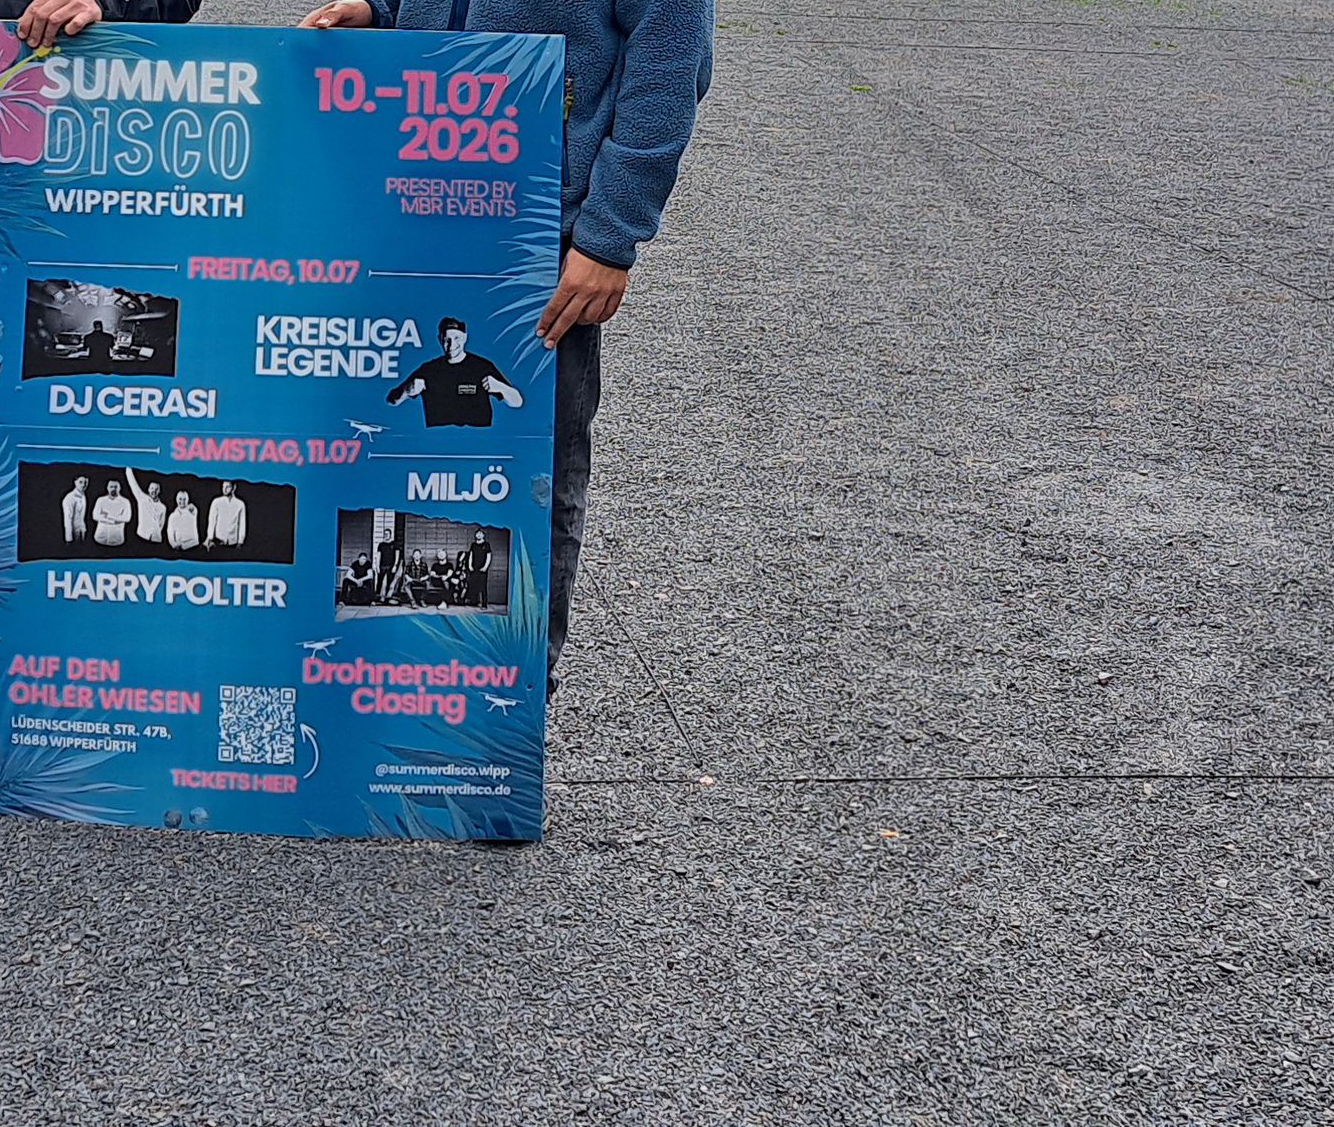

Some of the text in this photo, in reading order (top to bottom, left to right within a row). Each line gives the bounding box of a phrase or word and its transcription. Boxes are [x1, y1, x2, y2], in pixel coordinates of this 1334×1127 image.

[39, 56, 261, 105] SUMMER
[398, 117, 520, 163] 2026
[45, 185, 244, 218] WIPPERFÜRTH
[385, 177, 517, 199] PRESENTED BY
[400, 197, 517, 218] MBR EVENTS
[187, 256, 361, 286] FREITAG, 10.07
[256, 315, 422, 348] KREISLIGA
[255, 347, 399, 378] LEGENDE
[49, 385, 216, 418] DJ CERASI
[171, 436, 362, 466] SAMSTAG, 11.07
[407, 465, 509, 502] MILJÖ
[47, 570, 287, 608] HARRY POLTER
[9, 654, 121, 682] AUF DEN
[301, 657, 518, 688] Drohnenshow
[8, 681, 201, 715] OHLER WIESEN
[350, 686, 466, 725] Closing
[12, 715, 110, 736] LÜDENSCHEIDER
[113, 723, 140, 737] STR.
[11, 734, 137, 753] 51688 WIPPERFÜRTH
[170, 768, 298, 794] TICKETS HIER
[374, 763, 511, 780] @summerdisco.wipp
[368, 782, 512, 796] www.summerdisco.de
